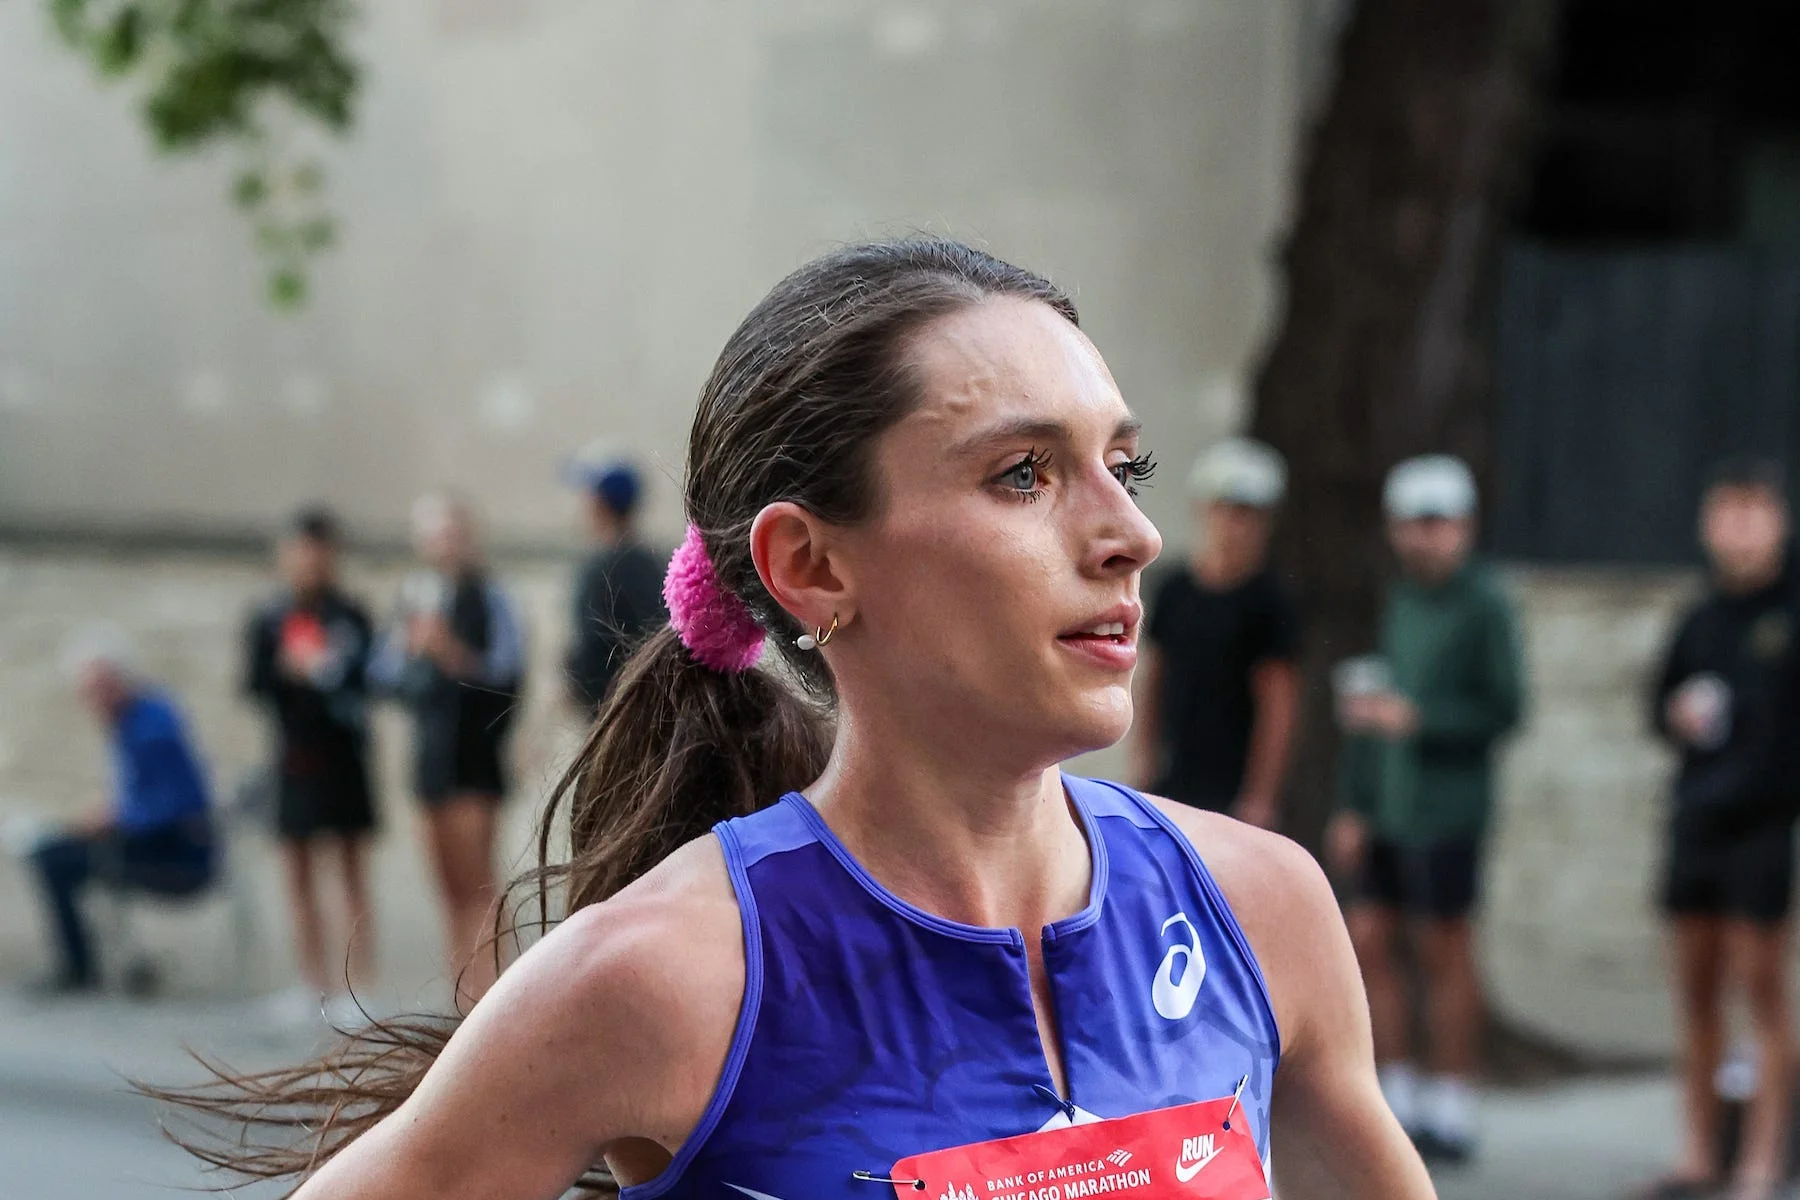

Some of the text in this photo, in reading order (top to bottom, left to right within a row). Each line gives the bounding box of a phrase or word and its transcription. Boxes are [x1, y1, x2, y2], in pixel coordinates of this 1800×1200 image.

[1180, 1133, 1214, 1163] RUN
[986, 1159, 1105, 1191] BANK OF AMERICA
[1063, 1168, 1151, 1200] MARATHON
